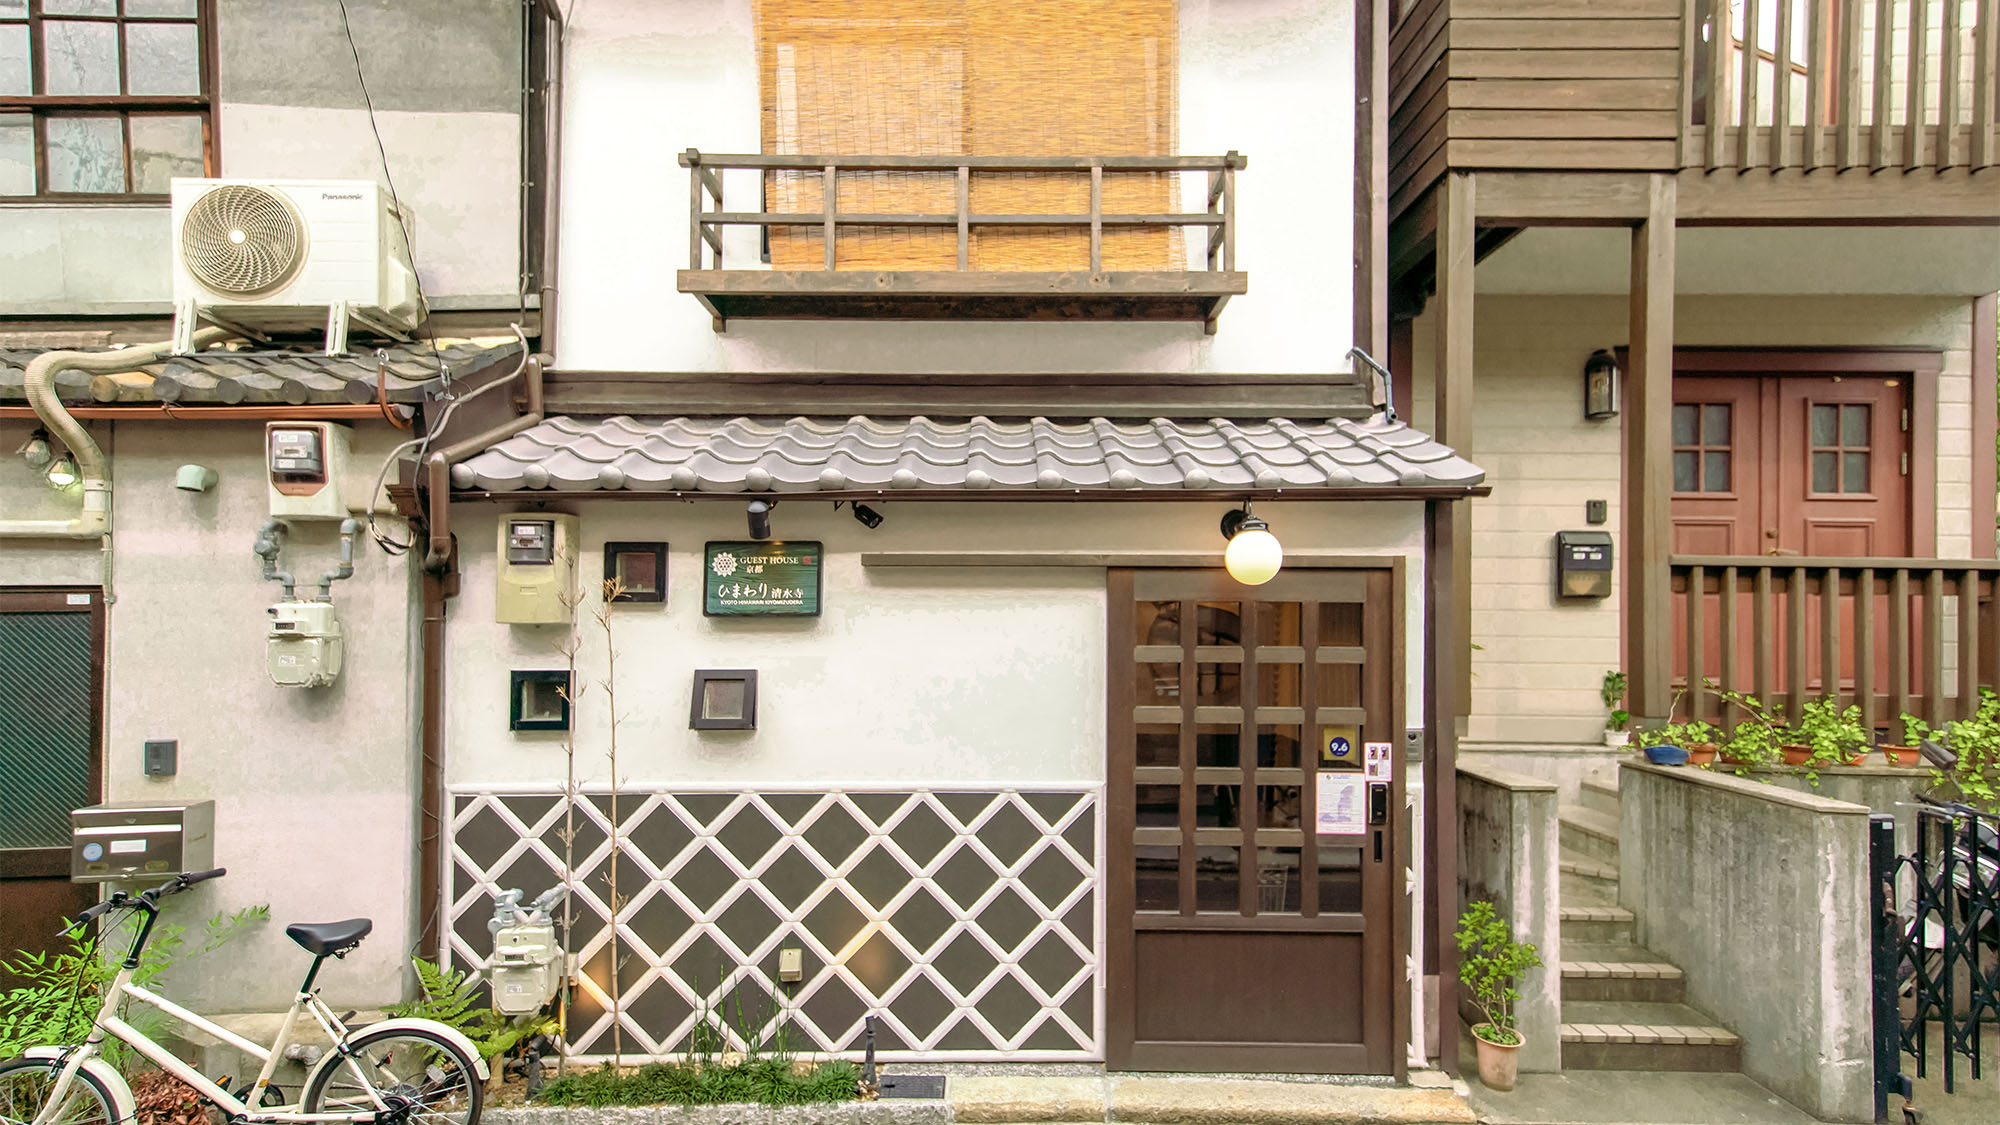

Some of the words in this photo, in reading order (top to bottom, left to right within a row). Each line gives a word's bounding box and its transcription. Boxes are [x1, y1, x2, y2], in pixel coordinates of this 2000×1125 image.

[740, 556, 768, 564] GUEST
[770, 556, 799, 564] HOUSE
[746, 565, 764, 574] 京都
[718, 583, 767, 598] ひまわり
[771, 588, 803, 598] 清水寺
[1331, 742, 1348, 752] 9.6
